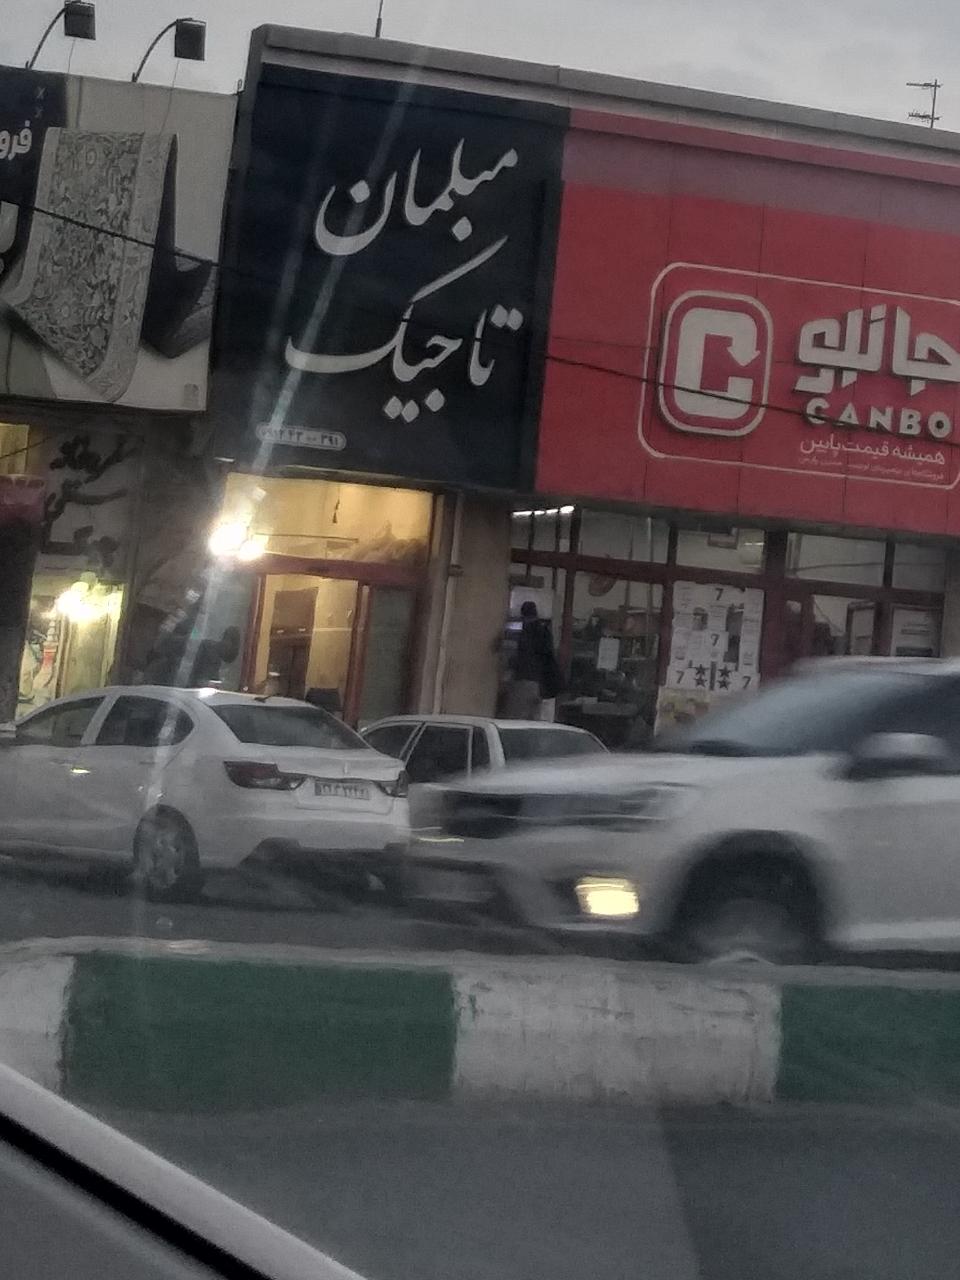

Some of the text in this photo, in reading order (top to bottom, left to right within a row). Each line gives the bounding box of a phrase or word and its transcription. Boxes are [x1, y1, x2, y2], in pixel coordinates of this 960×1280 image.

[315, 138, 518, 255] مبلمان
[285, 235, 523, 422] تاجیک
[800, 433, 946, 466] همیشه قیمت پایین
[806, 397, 952, 438] CANBO
